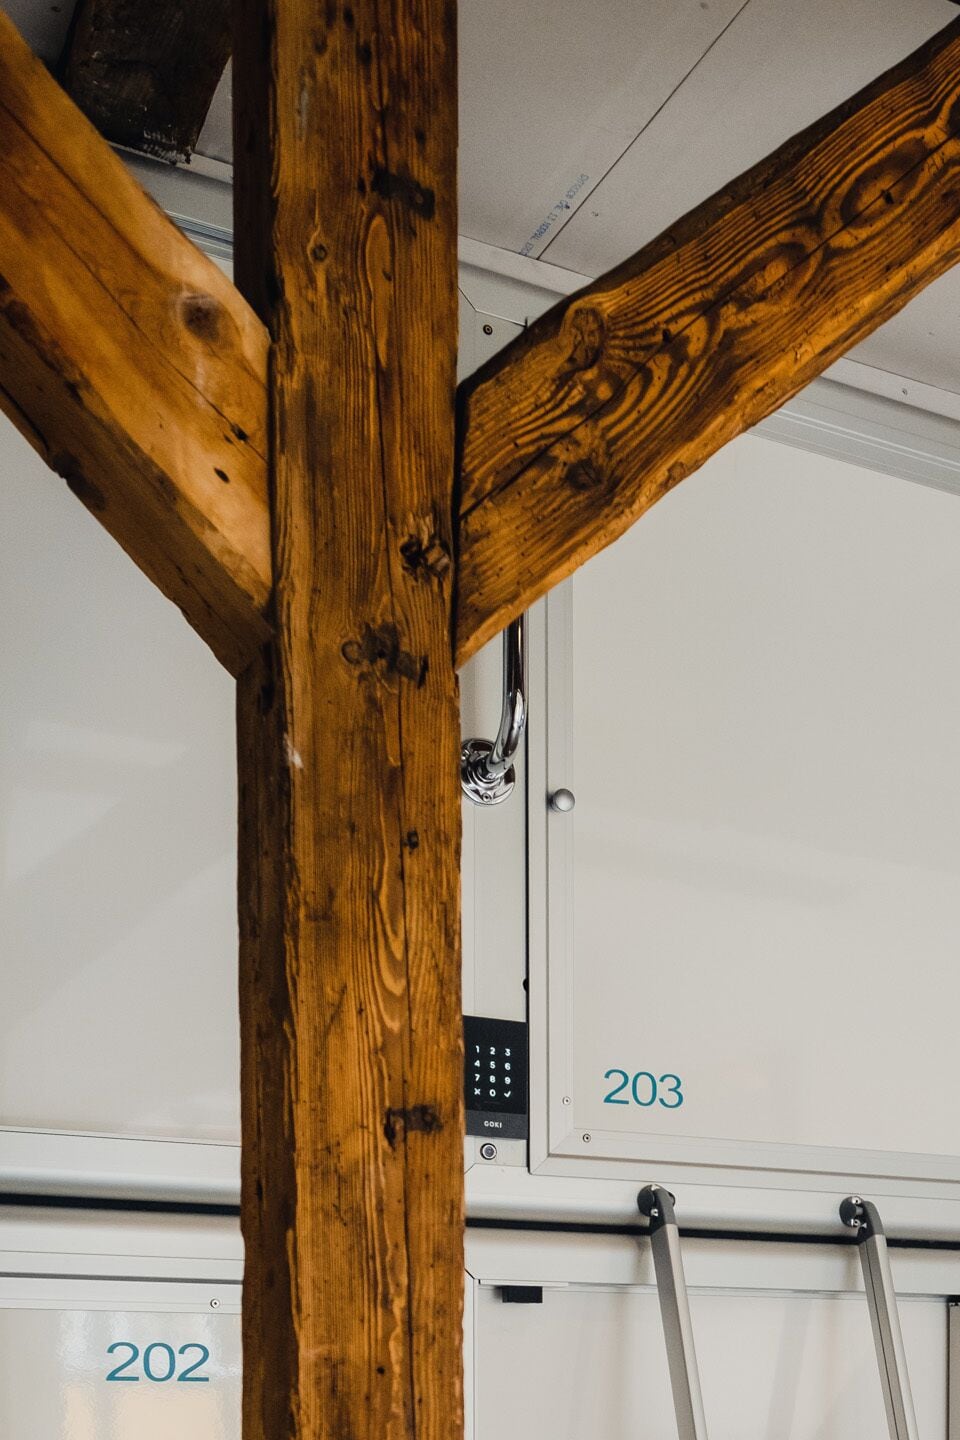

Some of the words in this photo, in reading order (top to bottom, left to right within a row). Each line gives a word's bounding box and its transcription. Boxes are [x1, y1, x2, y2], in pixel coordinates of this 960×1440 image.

[475, 1045, 480, 1054] 1
[489, 1046, 496, 1056] 2
[504, 1048, 511, 1057] 3
[474, 1059, 481, 1068] 4
[489, 1060, 496, 1069] 5
[504, 1062, 511, 1071] 6
[474, 1073, 481, 1082] 7
[489, 1075, 496, 1084] 8
[504, 1076, 511, 1085] 9
[489, 1088, 497, 1098] 0
[602, 1068, 685, 1109] 203
[483, 1120, 503, 1129] GOKI
[106, 1341, 209, 1382] 202
